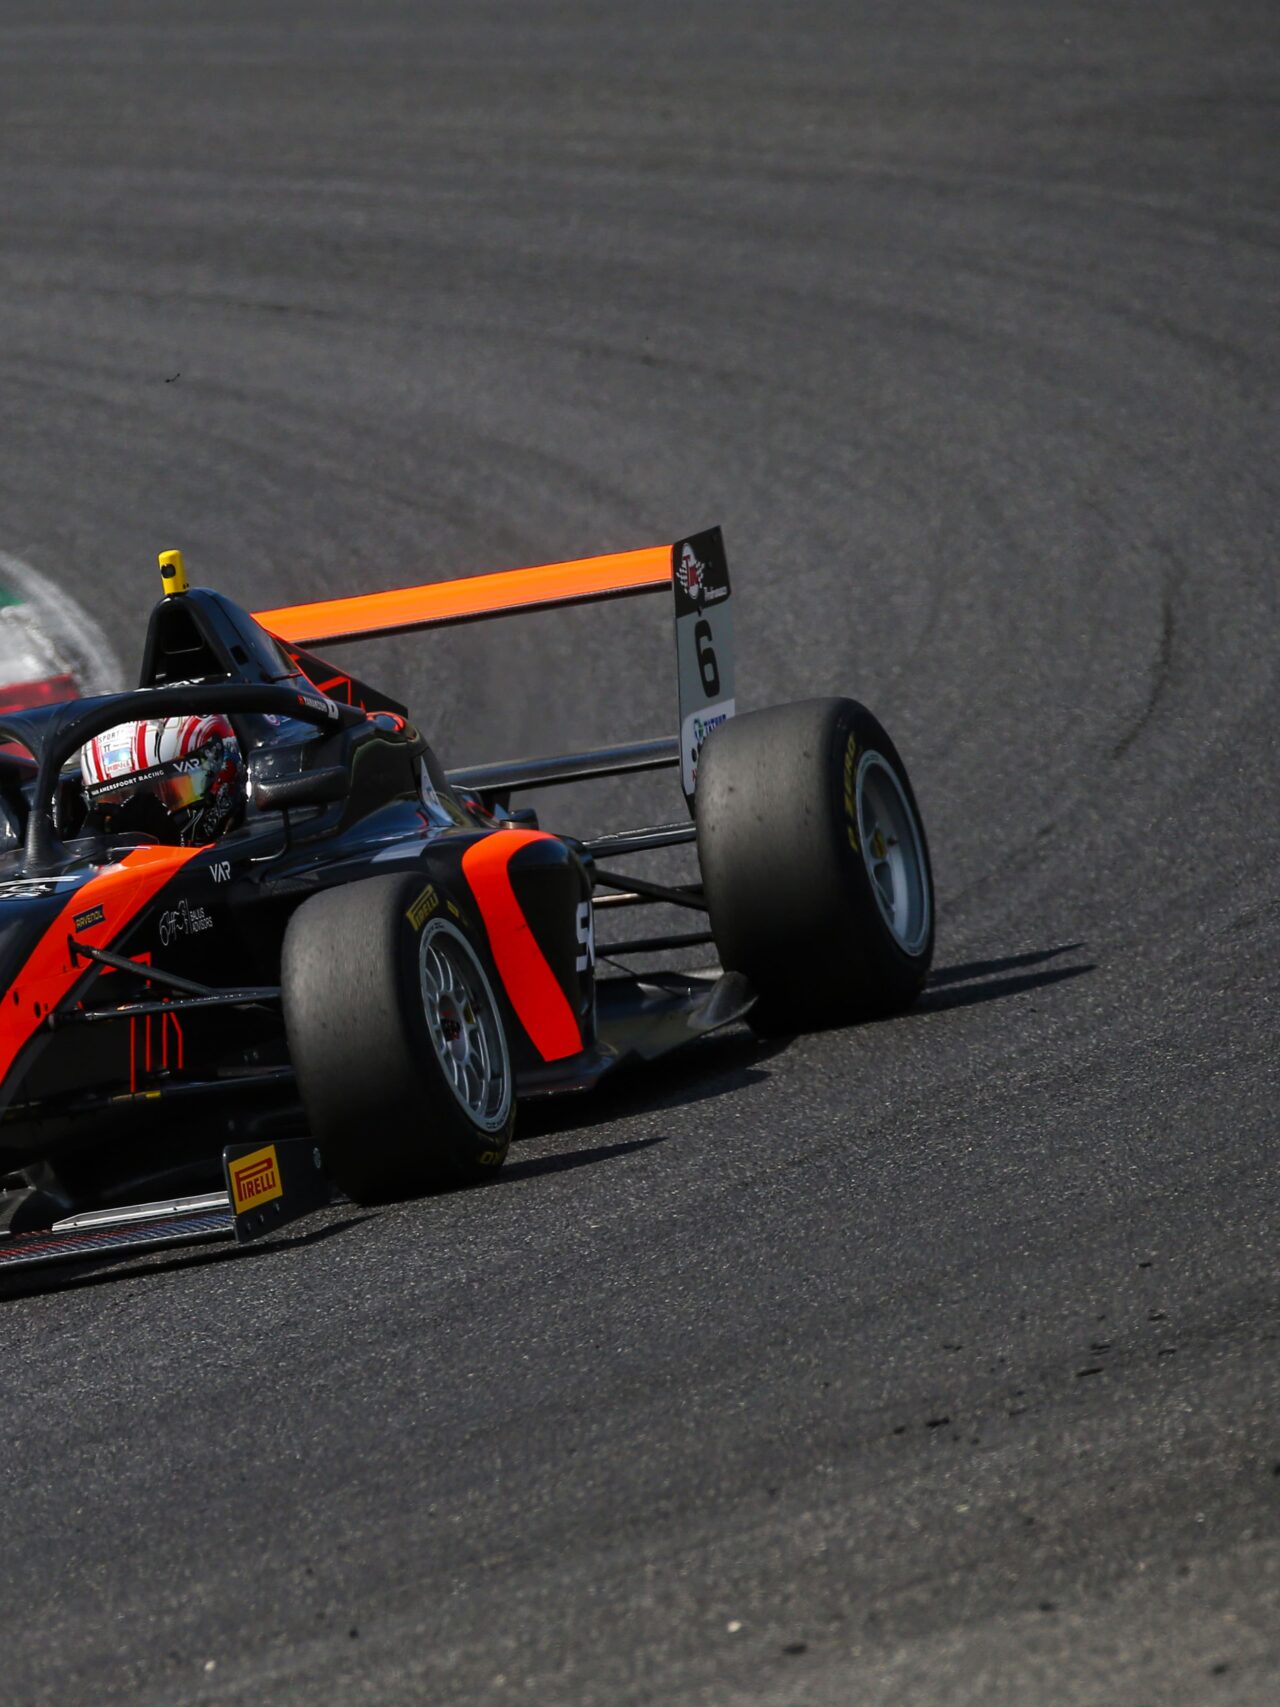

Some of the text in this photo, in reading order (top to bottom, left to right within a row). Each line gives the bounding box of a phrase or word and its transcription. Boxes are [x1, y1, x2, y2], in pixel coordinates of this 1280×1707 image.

[694, 619, 720, 698] 6
[138, 770, 165, 781] RACING
[173, 758, 200, 774] VAR
[209, 861, 231, 882] VAR
[405, 884, 440, 932] PIRELLI
[234, 1157, 276, 1202] PIRELLI
